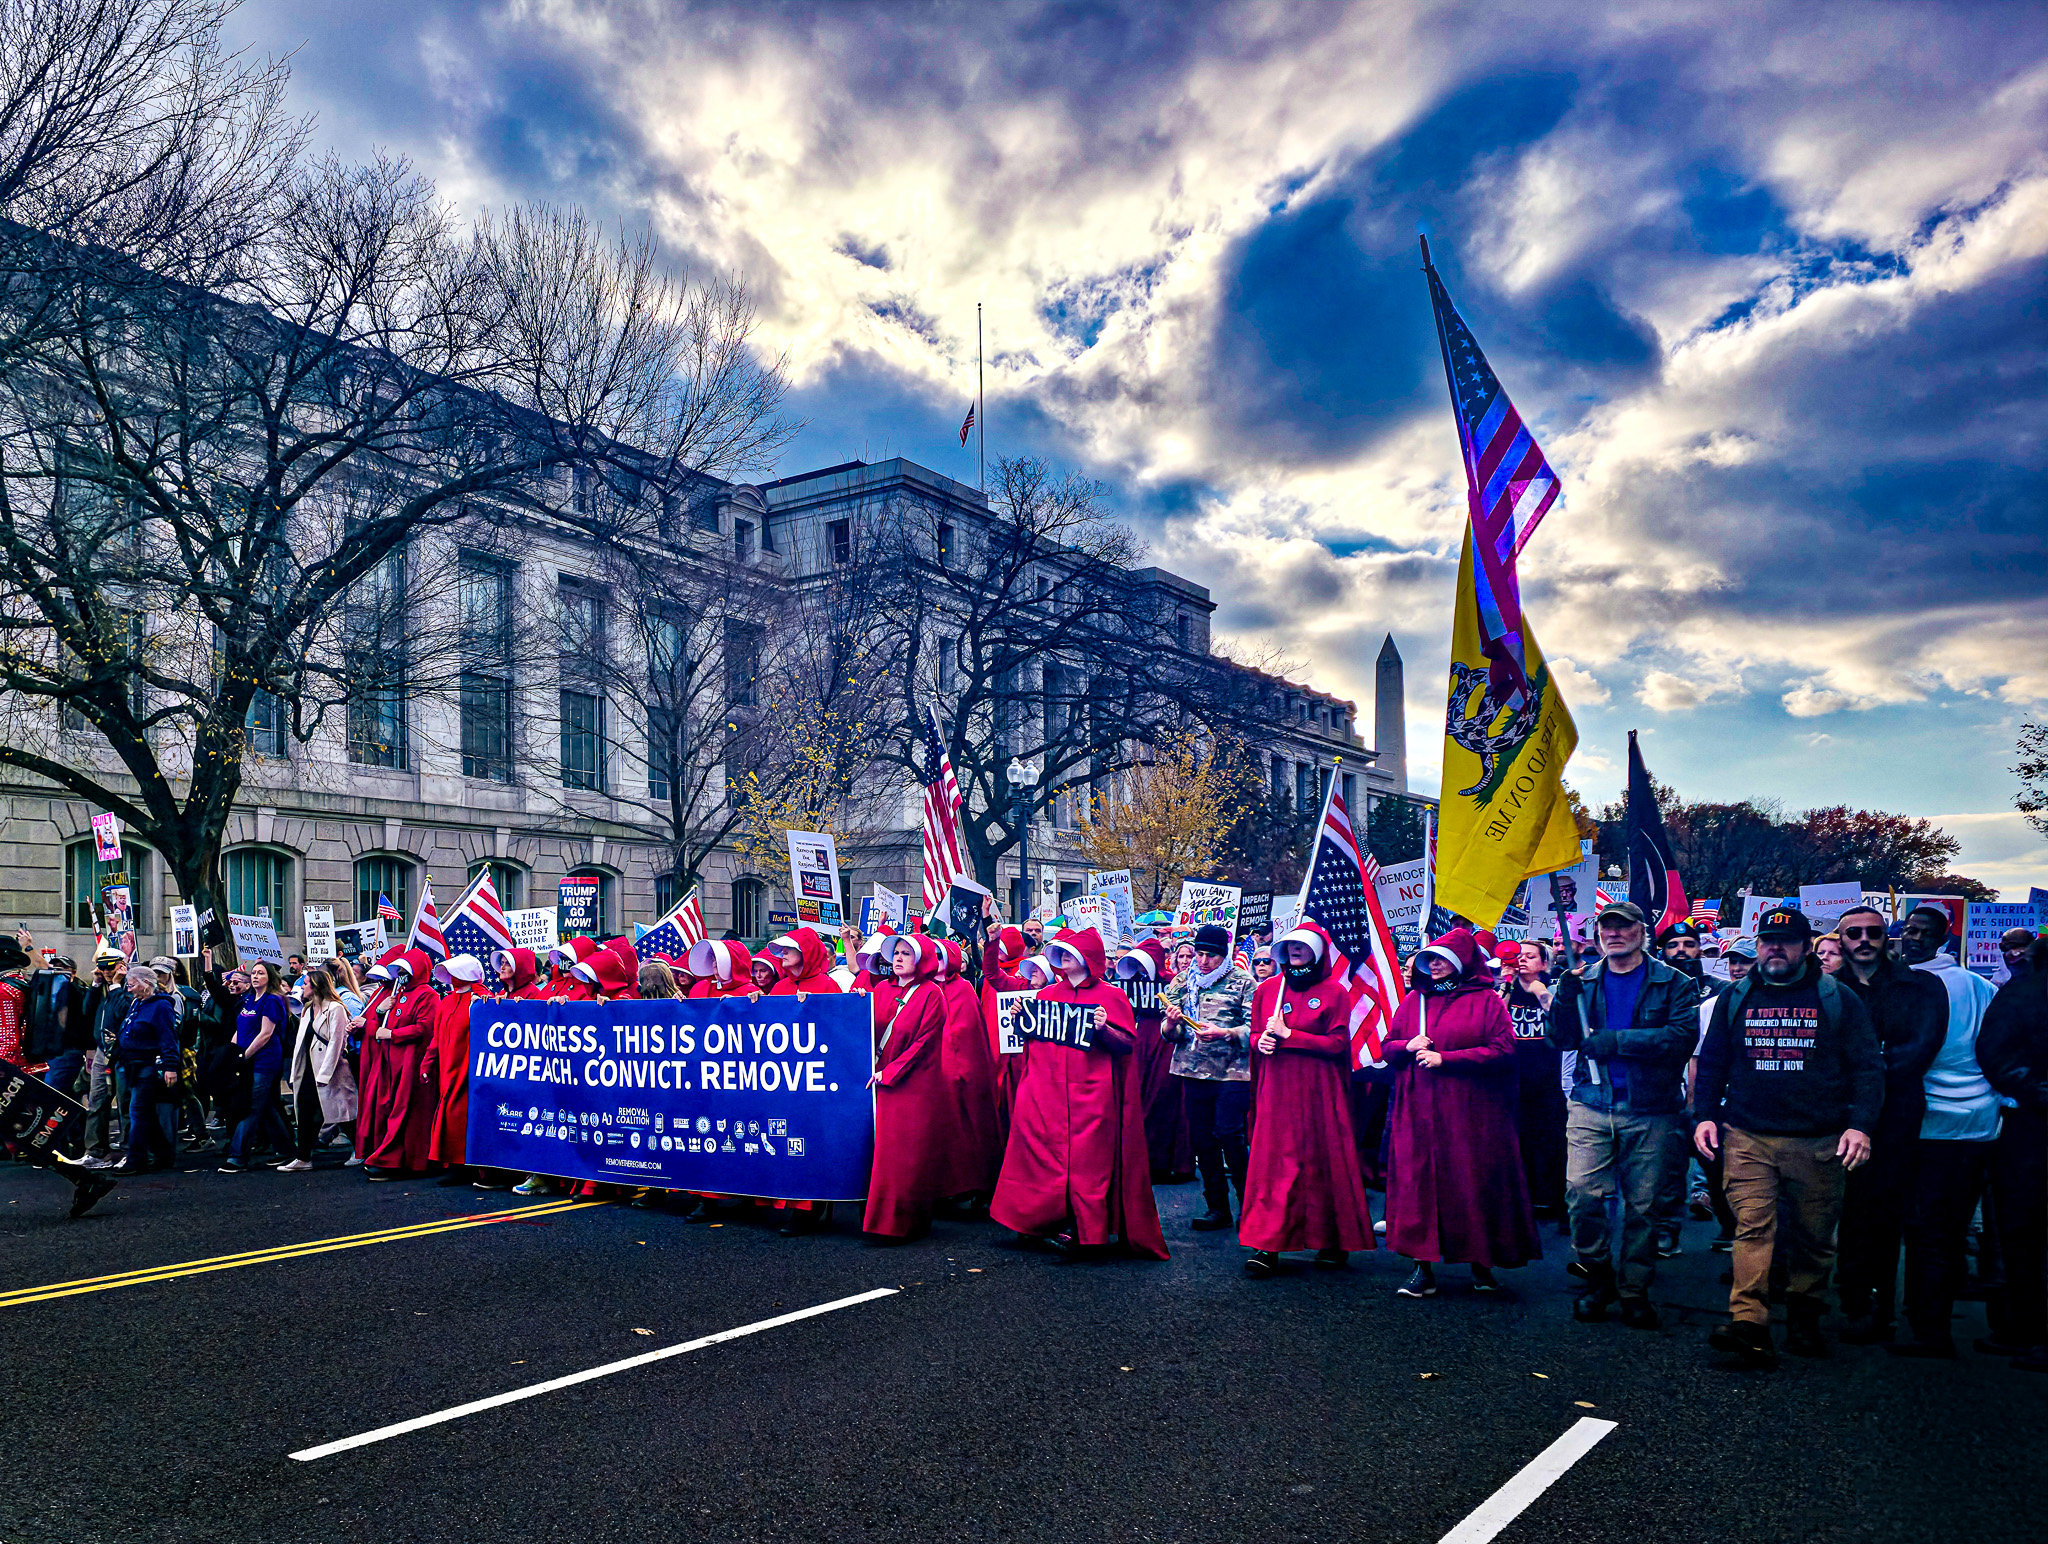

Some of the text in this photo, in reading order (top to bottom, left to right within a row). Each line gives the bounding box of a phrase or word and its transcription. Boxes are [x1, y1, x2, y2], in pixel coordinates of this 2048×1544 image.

[92, 813, 112, 827] QUIET
[99, 847, 119, 861] PIGGY
[1114, 873, 1129, 885] HAD
[1379, 867, 1425, 886] DEMOCR
[560, 886, 597, 896] TRUMP
[1189, 887, 1233, 899] YOU CAN'T
[563, 897, 592, 907] MUST
[798, 899, 818, 907] IMPEACH
[1242, 894, 1270, 905] IMPEACH
[570, 907, 585, 917] GO
[798, 906, 819, 915] CONVICT
[1080, 905, 1100, 914] OUT!
[1241, 904, 1269, 915] CONVICT
[1387, 903, 1422, 919] DICTAT
[1971, 905, 2035, 914] IN AMERICA
[521, 912, 541, 921] THE
[772, 914, 783, 922] Hot
[1767, 913, 1791, 925] FDT
[229, 916, 274, 930] ROT IN PRISON
[514, 919, 548, 929] TRUMP
[564, 918, 592, 928] NOW!
[867, 921, 899, 935] TRMP
[1972, 918, 2035, 927] WE SHOULD
[239, 932, 269, 943] NOT THE
[510, 927, 549, 938] FASCIST
[1396, 934, 1421, 942] ONVICT
[1968, 930, 1987, 939] NOT
[517, 935, 547, 945] EGIME
[259, 946, 283, 959] HOUSE
[1758, 1007, 1789, 1018] YOU'VE
[1793, 1008, 1817, 1018] EVER
[1019, 997, 1095, 1048] SHAME
[1745, 1019, 1818, 1027] WONDERED WHAT YOU
[1512, 1022, 1545, 1037] RUM
[1745, 1028, 1770, 1037] WOULD
[1773, 1028, 1793, 1037] HAVE
[487, 1021, 829, 1060] CONGRESS, THIS IS ON YOU.
[1744, 1038, 1752, 1046] IN
[1777, 1038, 1816, 1048] GERMANY.
[1756, 1060, 1804, 1071] RIGHT NOW
[475, 1051, 839, 1092] IMPEACH. CONVICT. REMOVE.
[618, 1106, 649, 1117] REMOVAL
[615, 1115, 650, 1126] COALITION
[31, 1106, 68, 1148] REMOVE
[605, 1157, 662, 1171] REMOVETHEREGIME.COM
